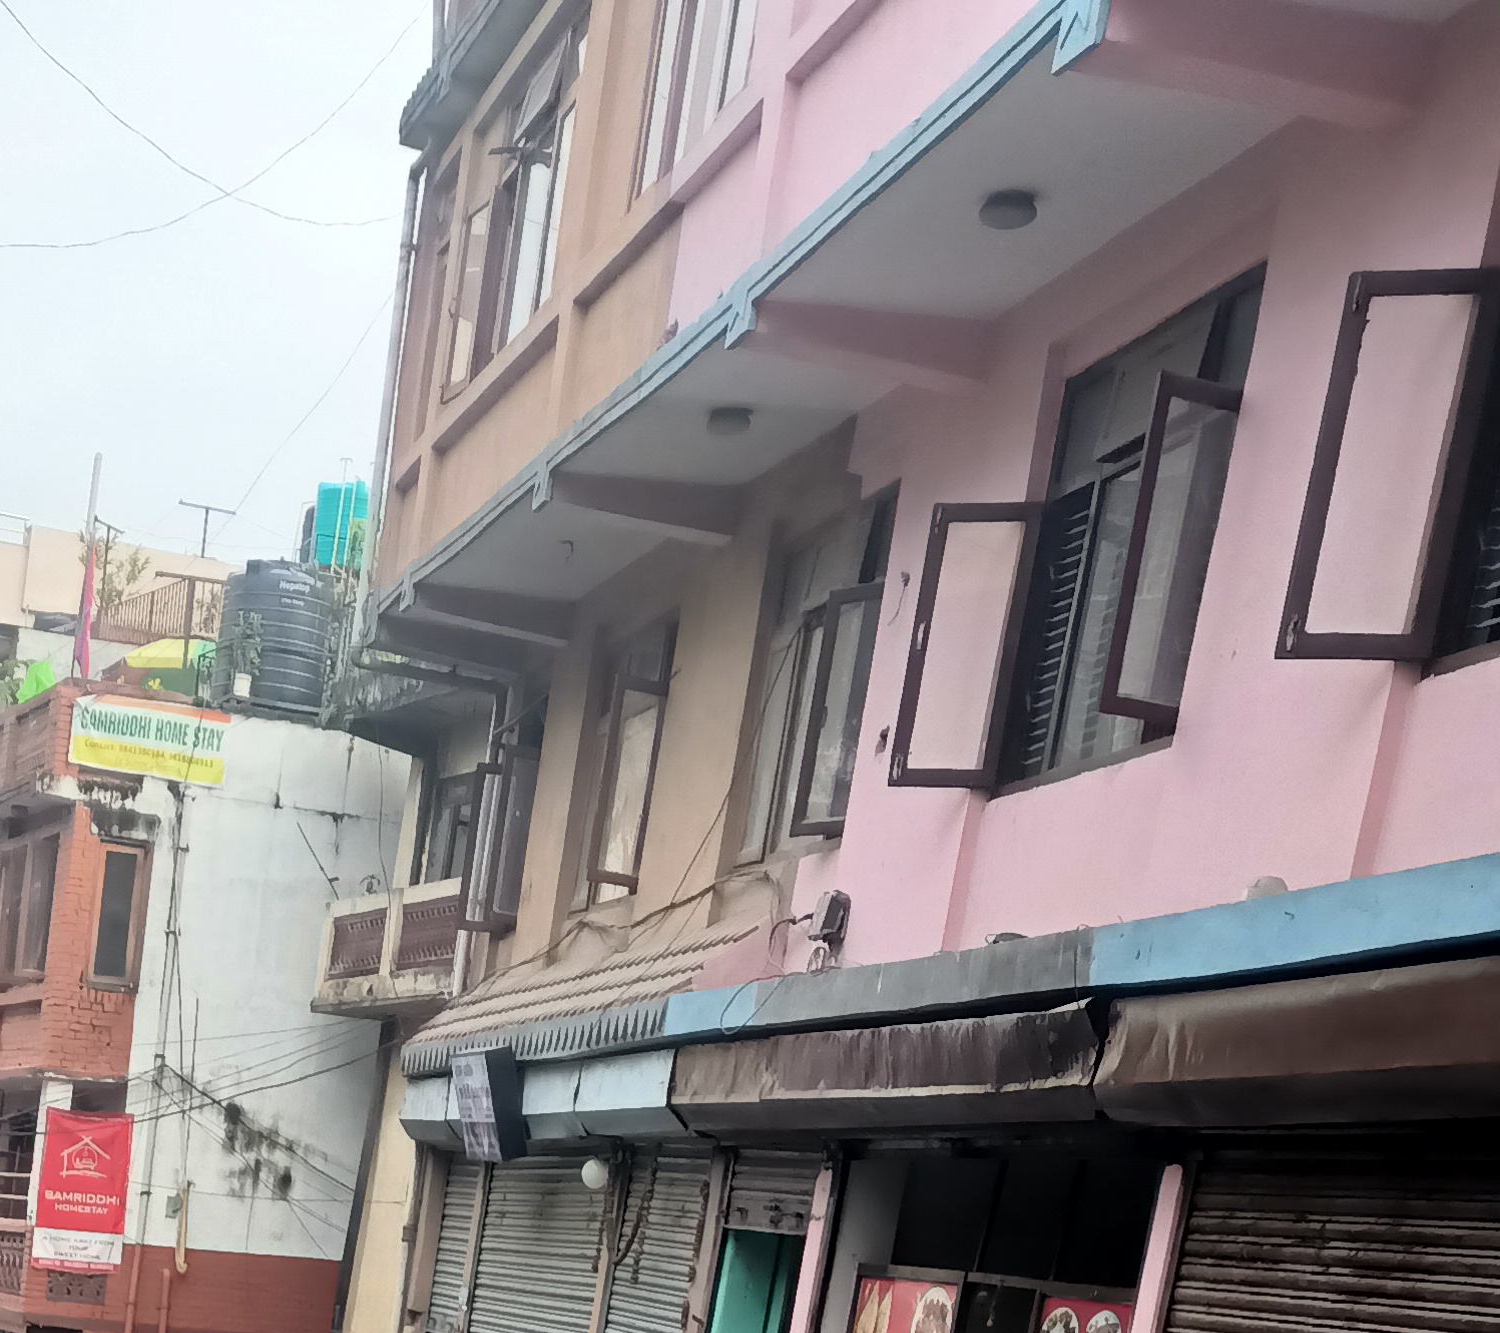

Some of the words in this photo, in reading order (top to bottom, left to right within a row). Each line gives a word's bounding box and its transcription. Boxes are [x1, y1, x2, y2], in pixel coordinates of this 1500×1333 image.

[80, 705, 150, 739] SAMRIDDHI
[155, 718, 189, 746] HOME
[193, 724, 225, 752] STAY
[45, 1190, 120, 1205] SAMRIDDHI
[55, 1203, 108, 1214] HOMESTAY
